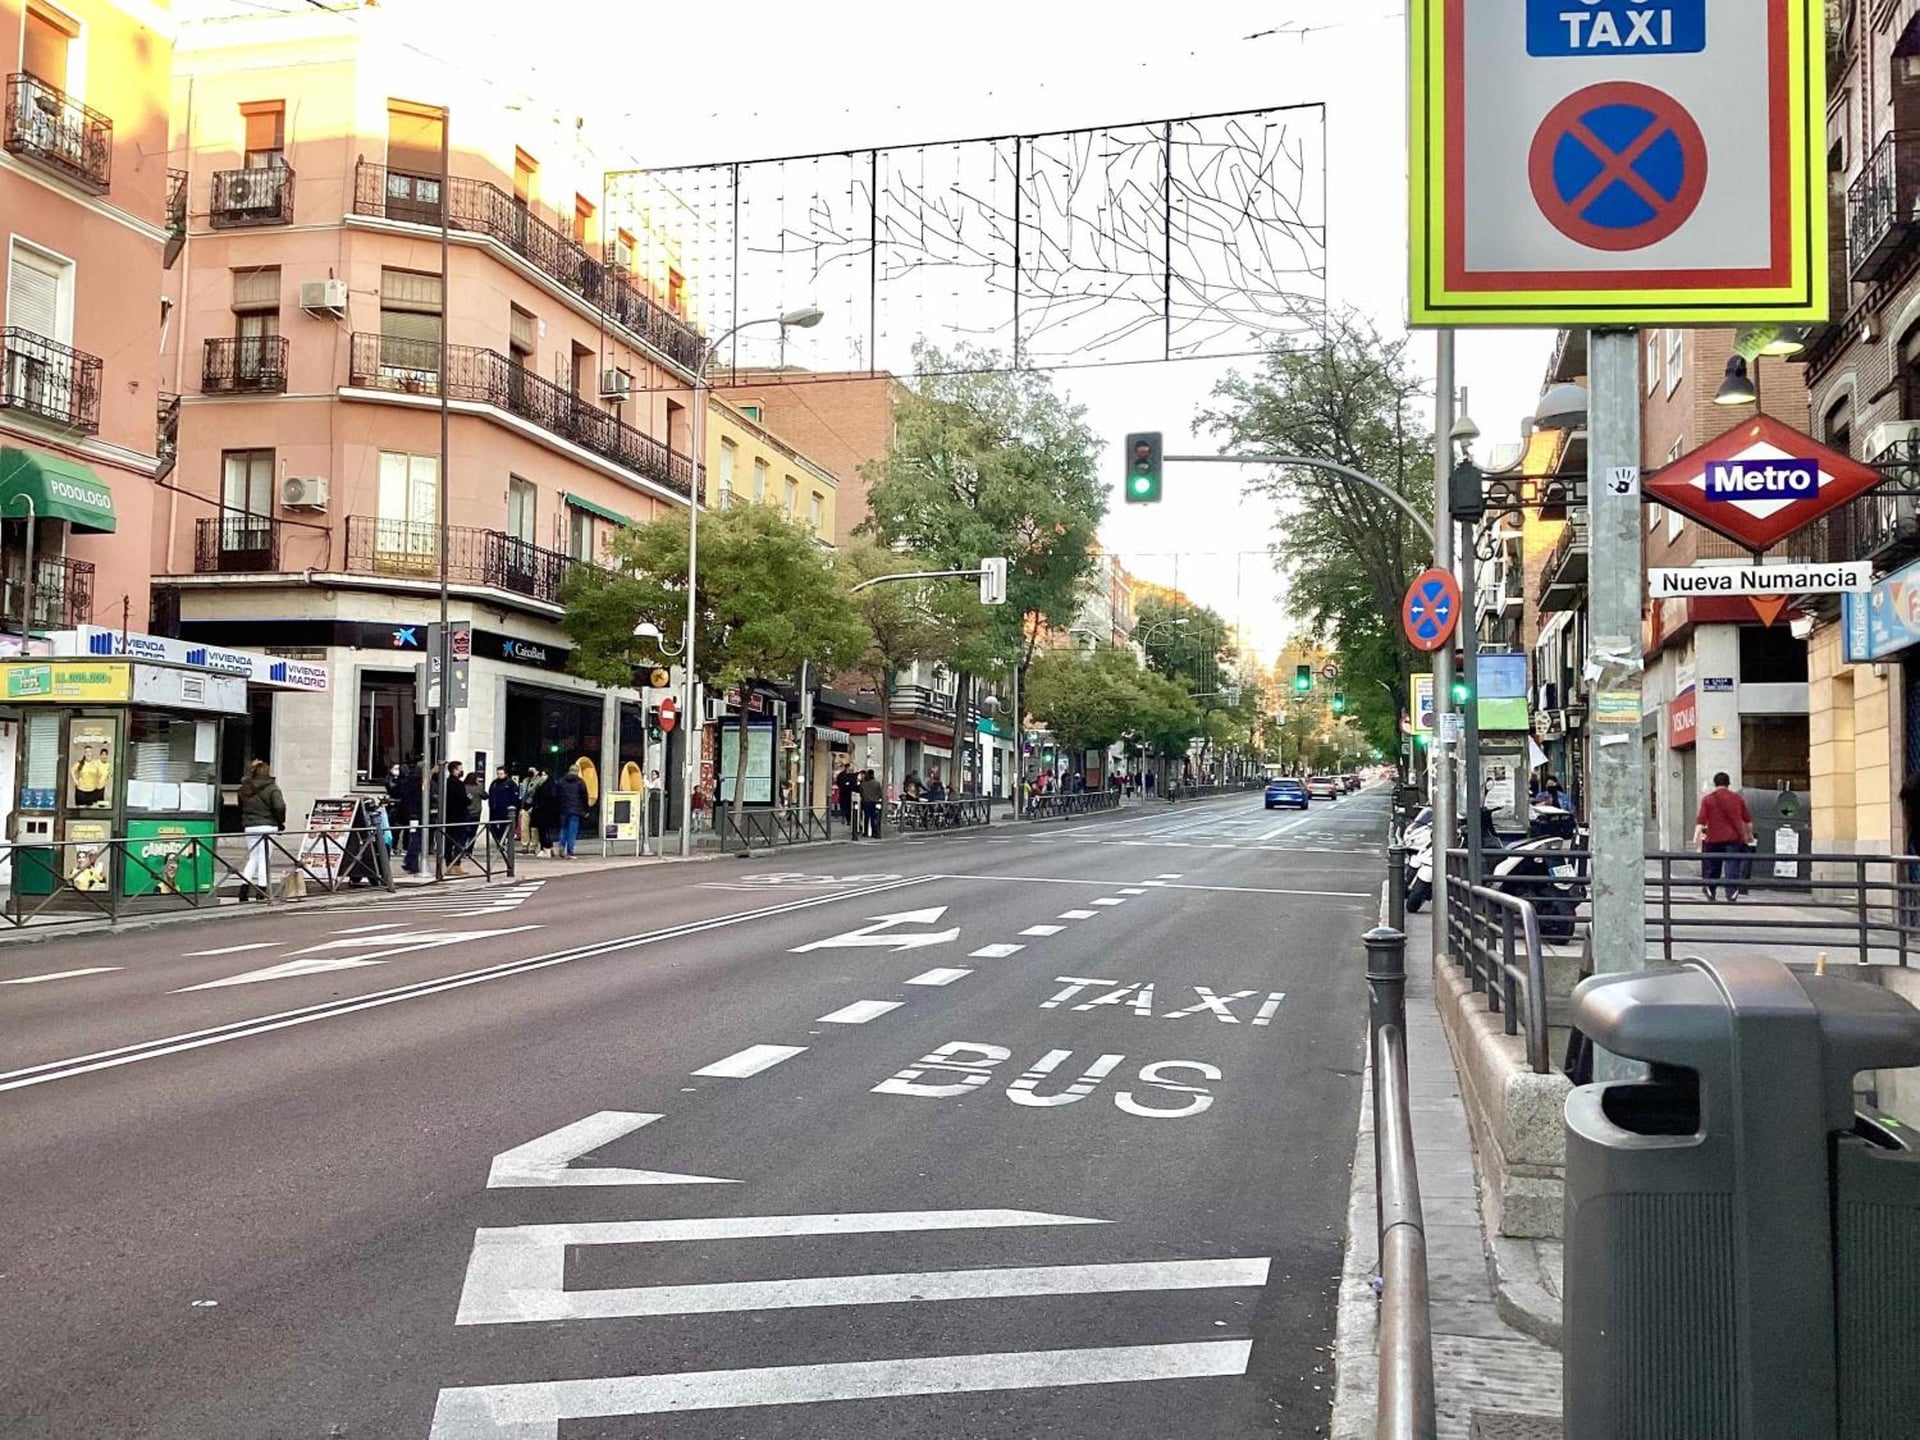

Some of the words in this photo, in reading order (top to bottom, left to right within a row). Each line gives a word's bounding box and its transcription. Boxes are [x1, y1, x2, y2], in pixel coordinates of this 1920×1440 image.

[1560, 9, 1672, 48] TAXI
[1714, 465, 1811, 493] Metro
[51, 480, 111, 509] PODOLOGO
[1663, 573, 1732, 592] Nueva
[1741, 568, 1857, 590] Numancia
[114, 635, 166, 652] VVIENDA
[208, 651, 252, 666] VIVIENDA
[288, 664, 326, 677] VIVIENDA
[288, 674, 326, 688] MADRID
[1039, 976, 1286, 1026] TAXI
[869, 1041, 1222, 1118] BUS
